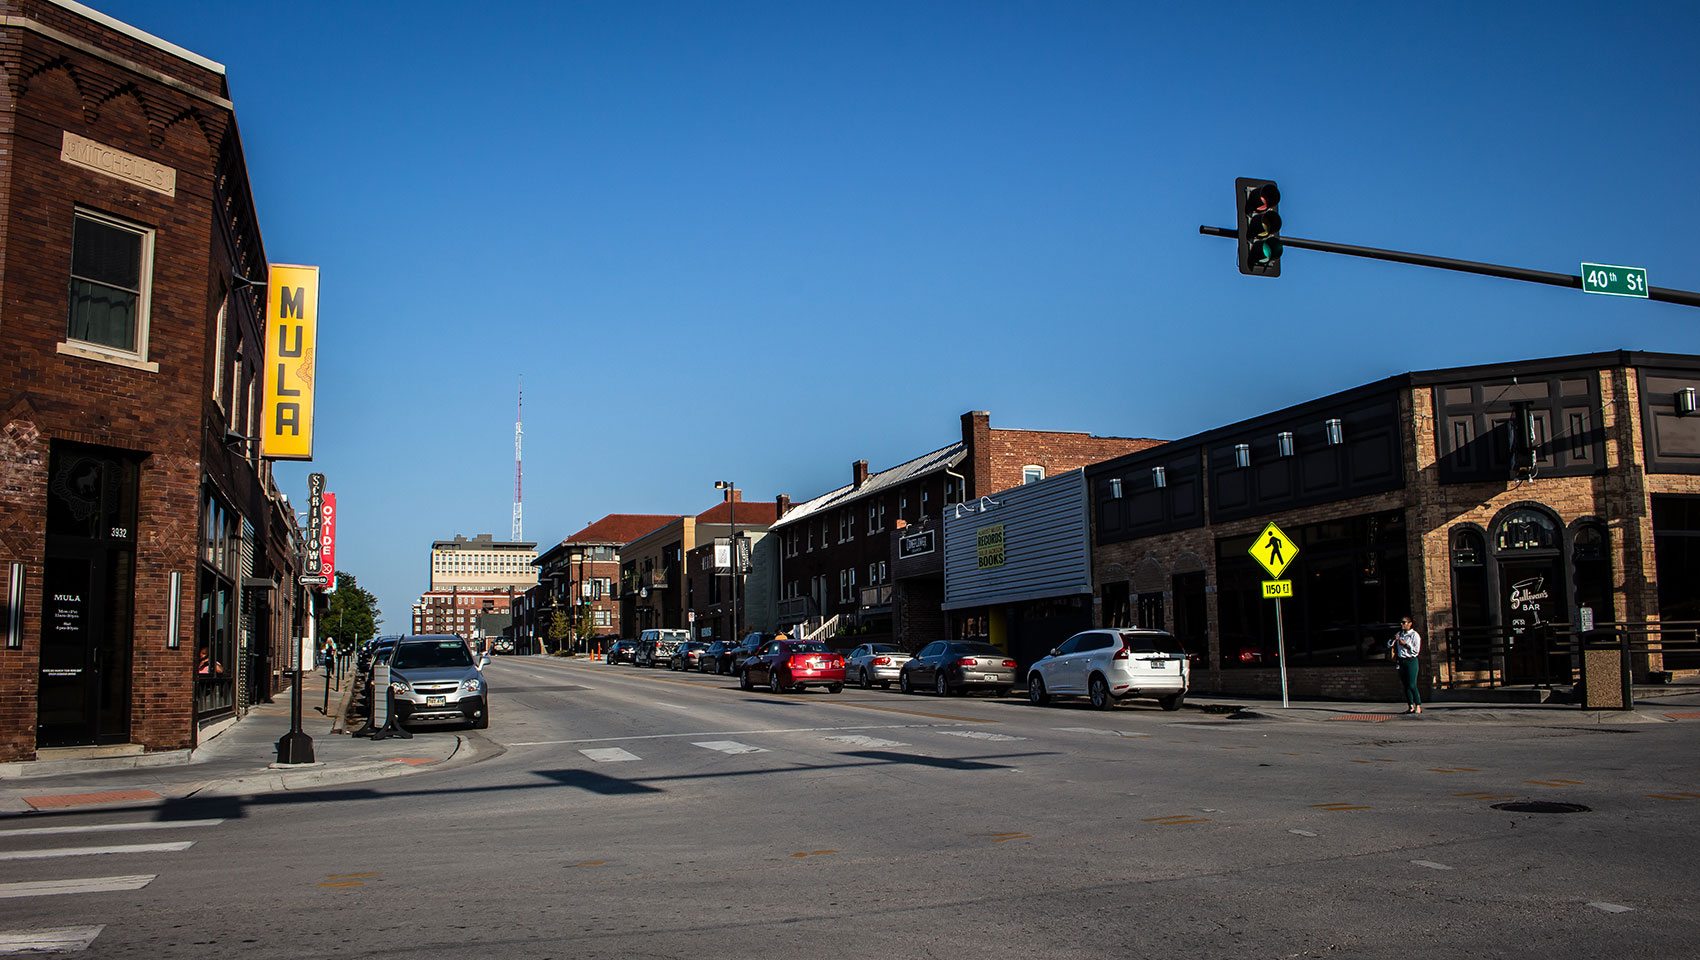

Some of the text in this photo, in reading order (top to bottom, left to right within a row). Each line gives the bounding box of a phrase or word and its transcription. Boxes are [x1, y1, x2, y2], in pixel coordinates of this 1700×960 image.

[77, 140, 165, 186] MITCHELL'S
[1587, 270, 1643, 291] 40th St
[276, 286, 305, 436] MULA
[309, 474, 320, 571] SCRIPTOWN
[322, 505, 333, 556] OXIDE
[111, 527, 127, 538] 3932
[978, 532, 1003, 547] RECORDS
[978, 553, 1004, 567] BOOKS
[53, 594, 81, 602] MULA
[1265, 584, 1281, 595] 1150
[1510, 588, 1548, 609] Sullivan's
[1522, 603, 1541, 611] BAR
